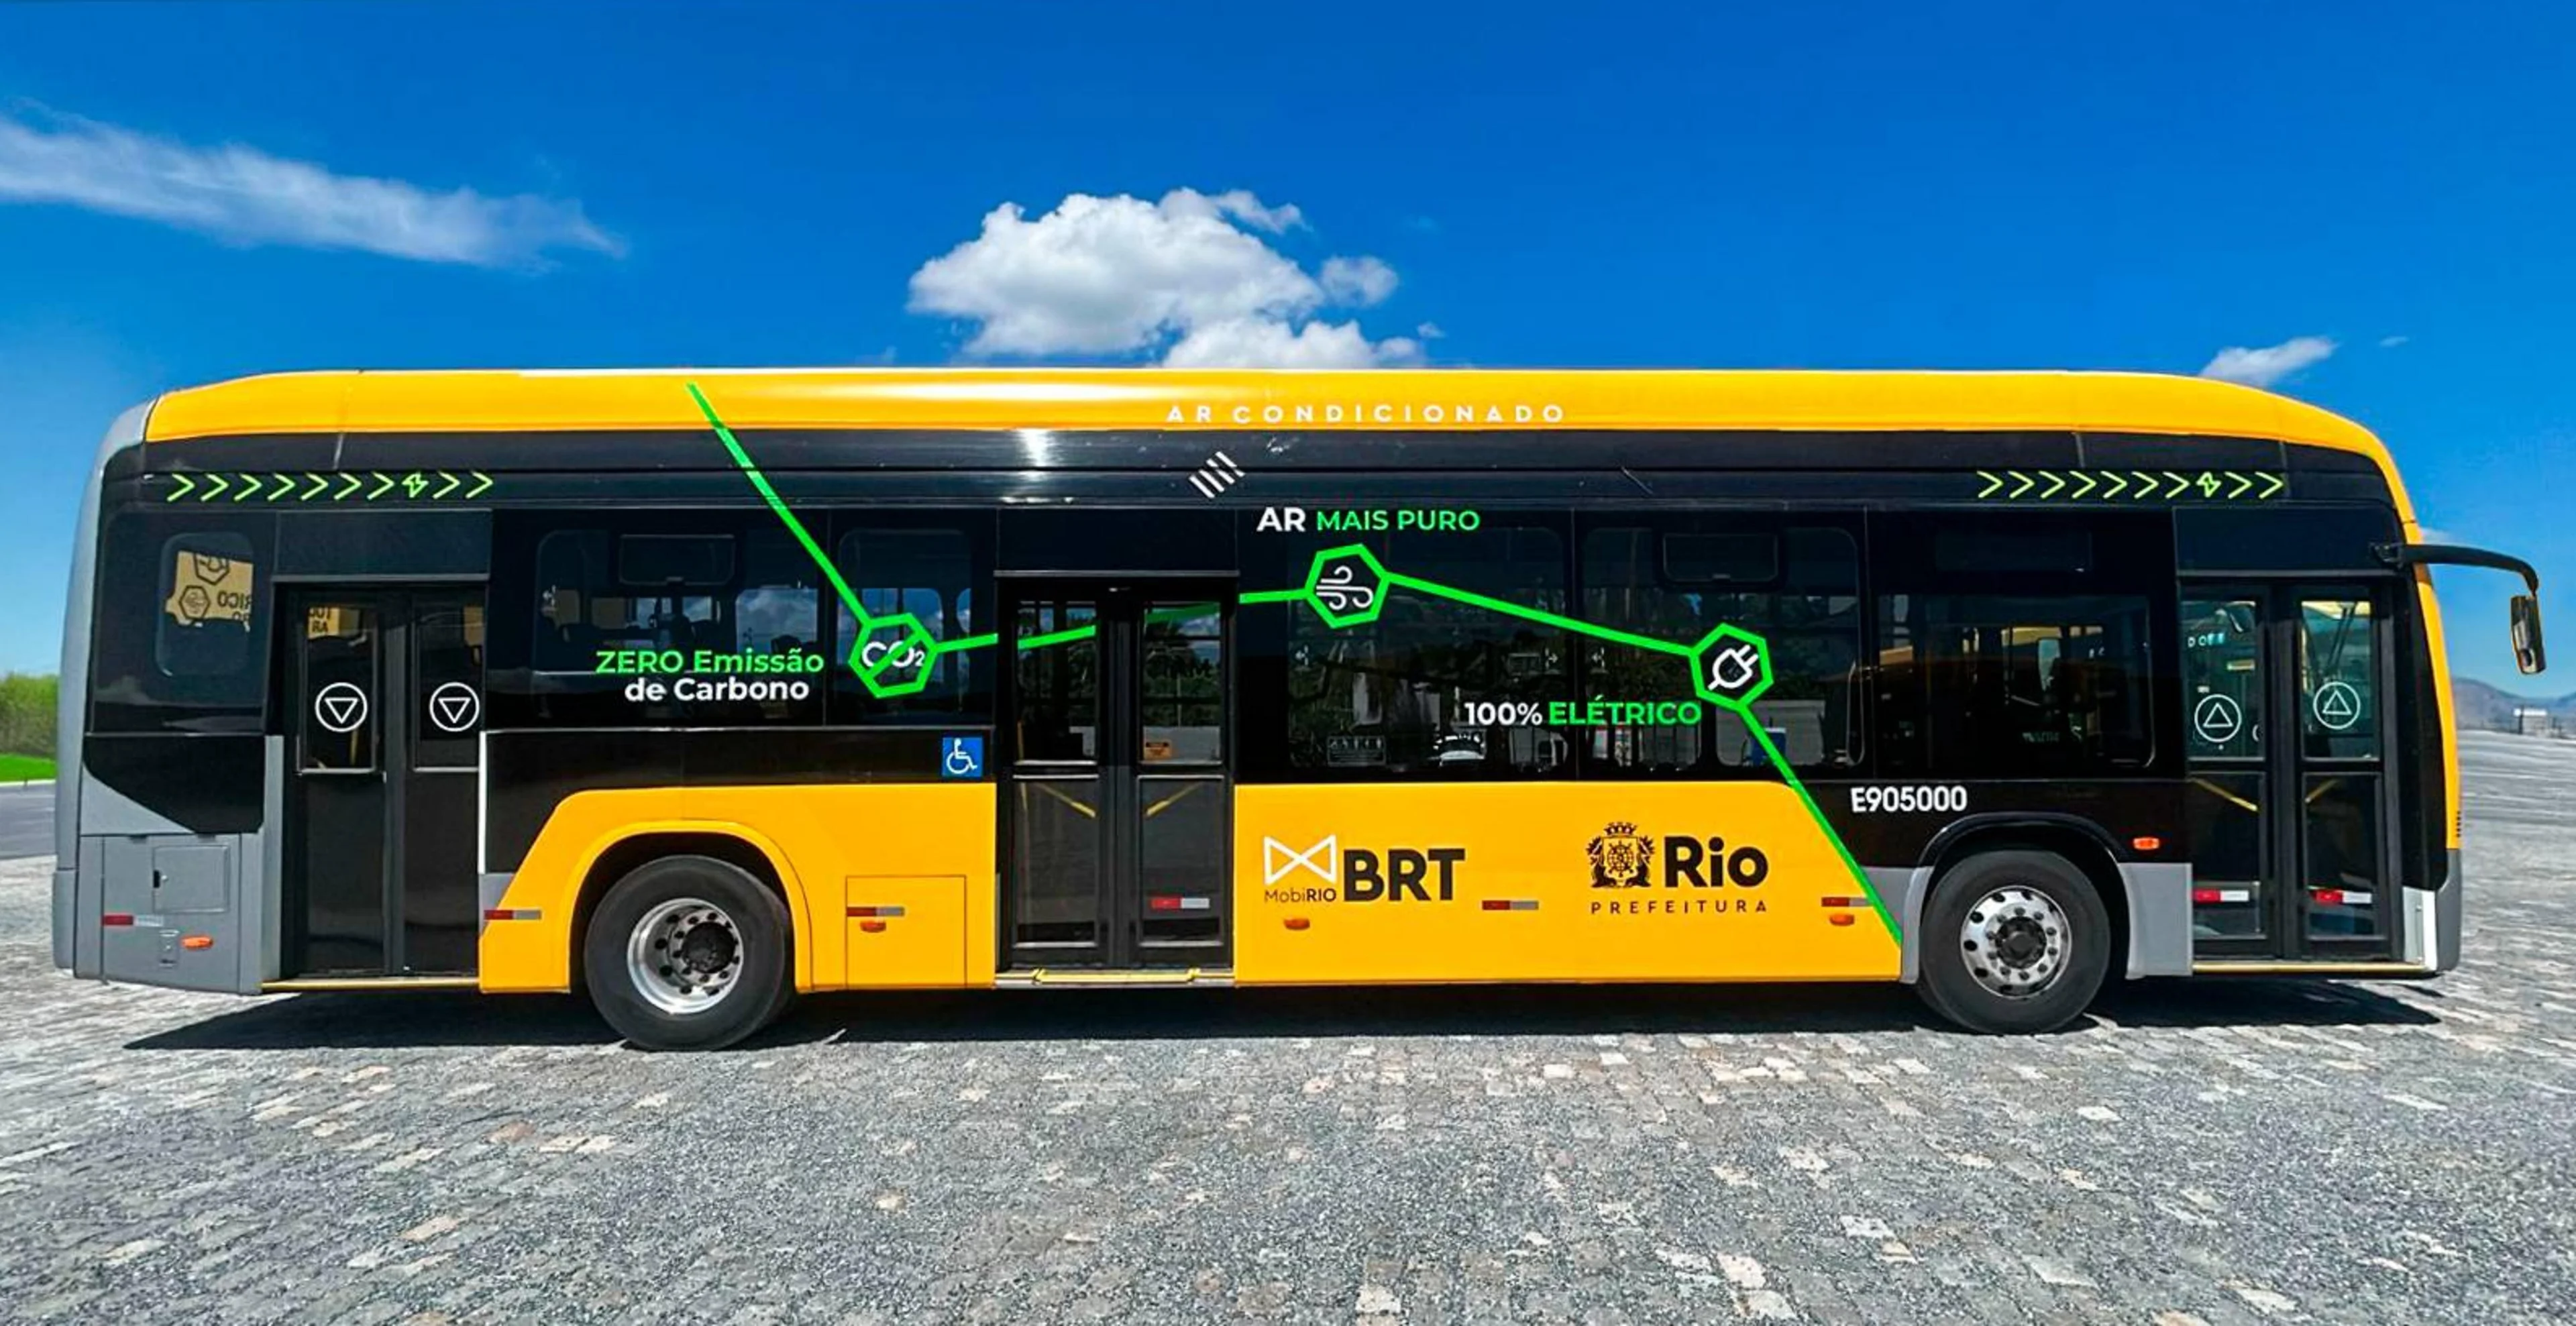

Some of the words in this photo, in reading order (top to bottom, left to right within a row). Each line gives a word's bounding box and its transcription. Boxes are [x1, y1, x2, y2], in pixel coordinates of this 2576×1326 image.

[1167, 405, 1212, 423] AR
[1233, 405, 1563, 423] CONDICIONADO
[1256, 506, 1305, 532] AR
[1317, 510, 1389, 531] MAIS
[1397, 510, 1480, 531] PURO
[595, 650, 684, 673] ZERO
[694, 647, 824, 673] Emissão
[625, 677, 666, 702] de
[674, 676, 809, 702] Carbono
[1464, 702, 1542, 726] 100%
[1549, 695, 1701, 726] ELÉTRICO
[1851, 785, 1967, 813] E905000
[1344, 848, 1465, 902] BRT
[1664, 836, 1768, 888] Rio
[1264, 888, 1336, 902] MobiRIO
[1592, 900, 1767, 914] PREFEITURA
